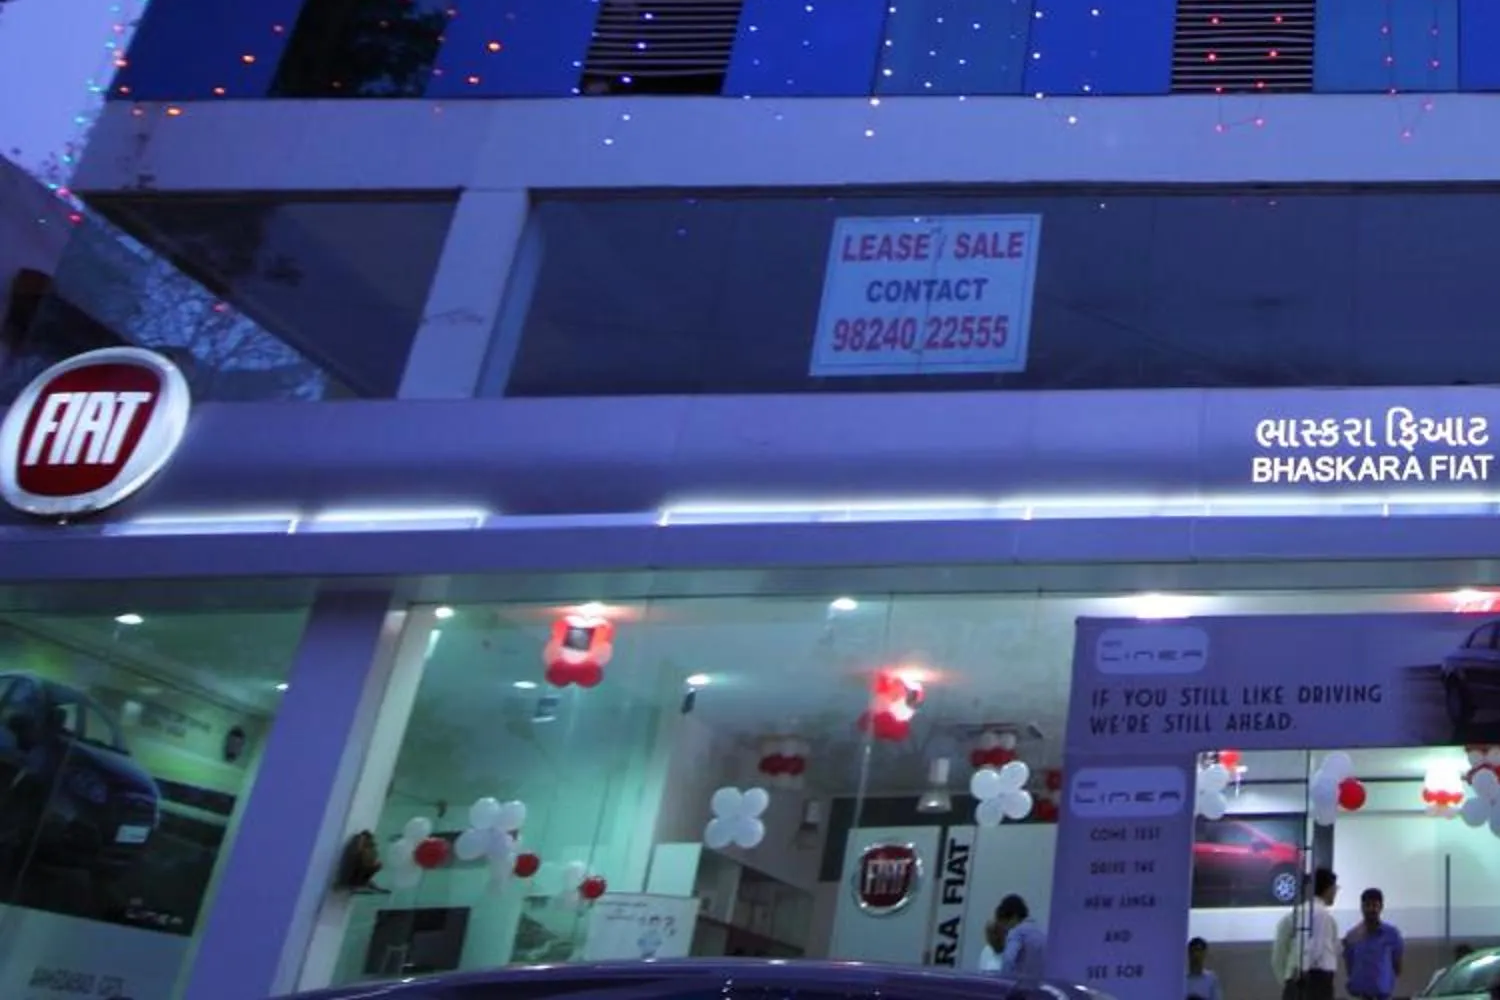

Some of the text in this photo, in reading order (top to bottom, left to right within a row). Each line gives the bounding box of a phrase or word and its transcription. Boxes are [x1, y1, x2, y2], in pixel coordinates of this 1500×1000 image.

[842, 234, 931, 262] LEASE
[953, 231, 1024, 259] SALE
[866, 278, 989, 303] CONTACT
[832, 315, 1009, 352] 98240 22555
[23, 391, 152, 466] FIAT
[1252, 454, 1495, 482] BHASKARA FIAT
[1091, 684, 1382, 708] IF YOU STILL LIKE DRIVING
[1089, 715, 1149, 735] WE'RE
[1164, 714, 1211, 733] STILL
[942, 837, 970, 905] FIAT
